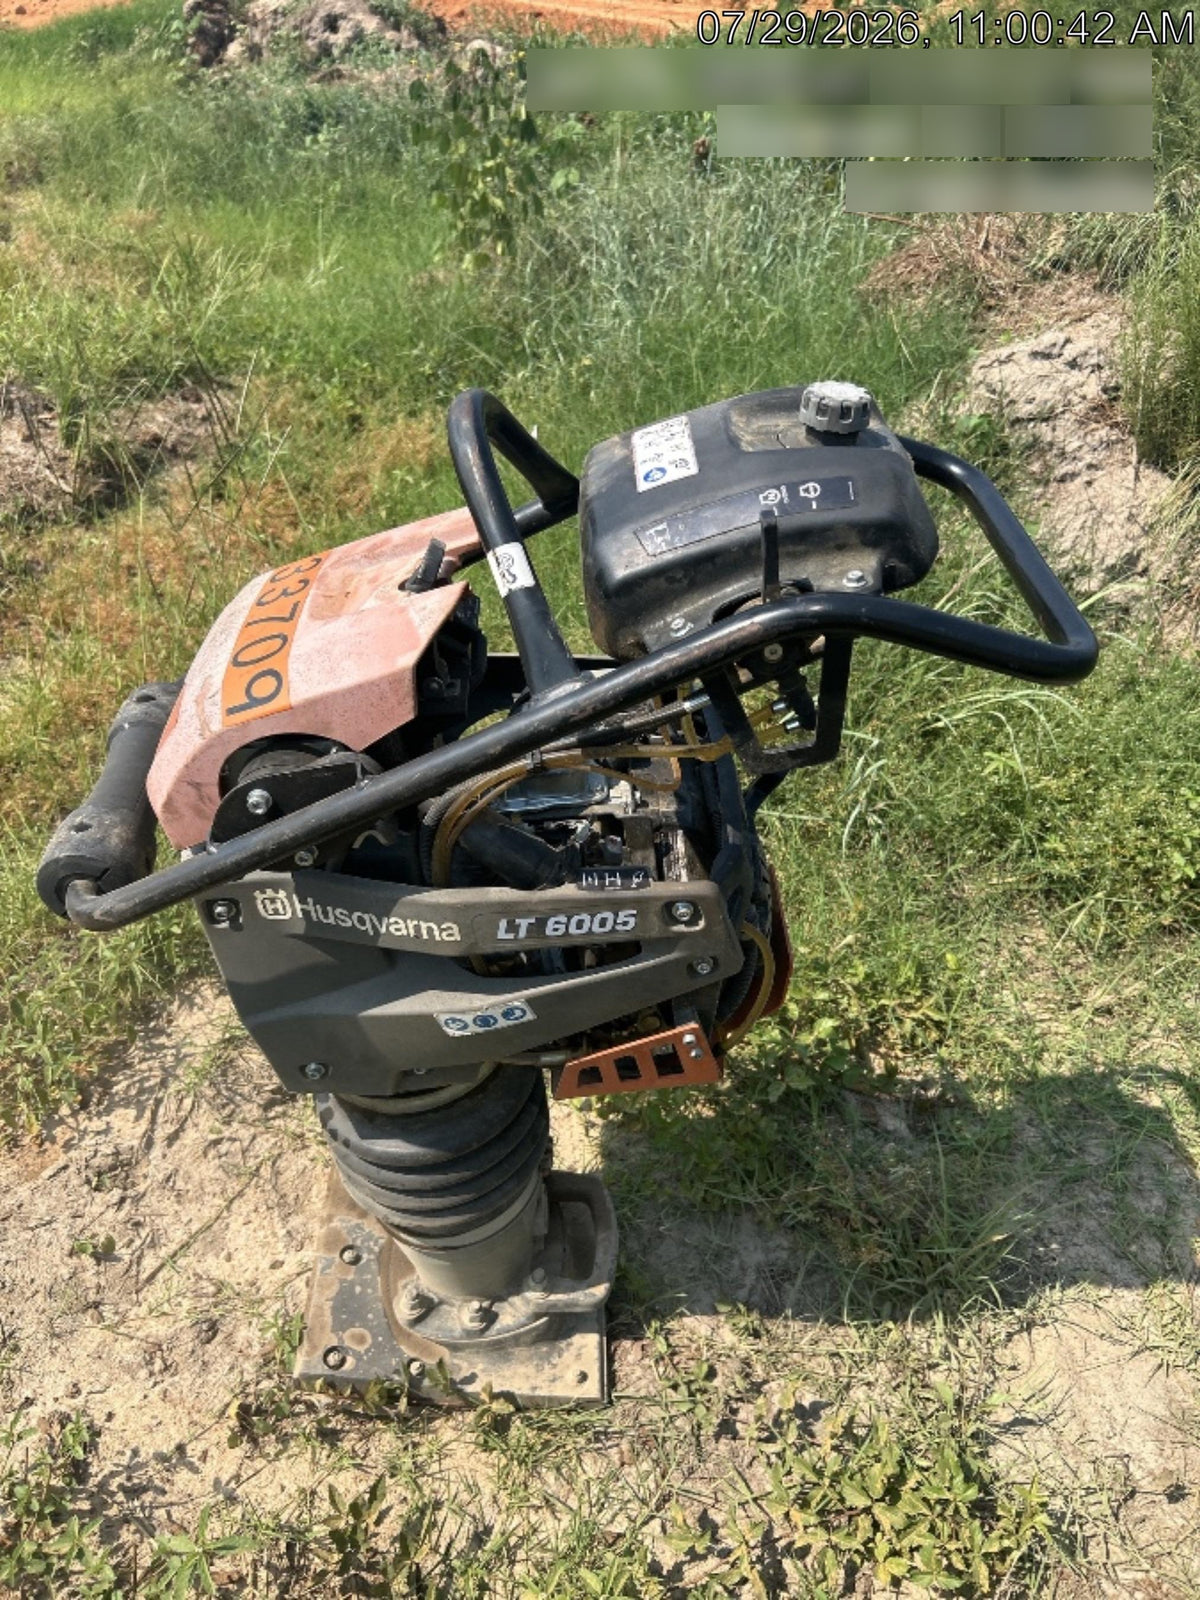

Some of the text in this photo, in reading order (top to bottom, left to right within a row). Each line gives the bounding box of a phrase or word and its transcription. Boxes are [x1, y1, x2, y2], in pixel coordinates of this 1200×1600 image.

[226, 557, 322, 716] 33709
[292, 893, 461, 942] Husqvarna
[497, 909, 638, 940] LT 6005
